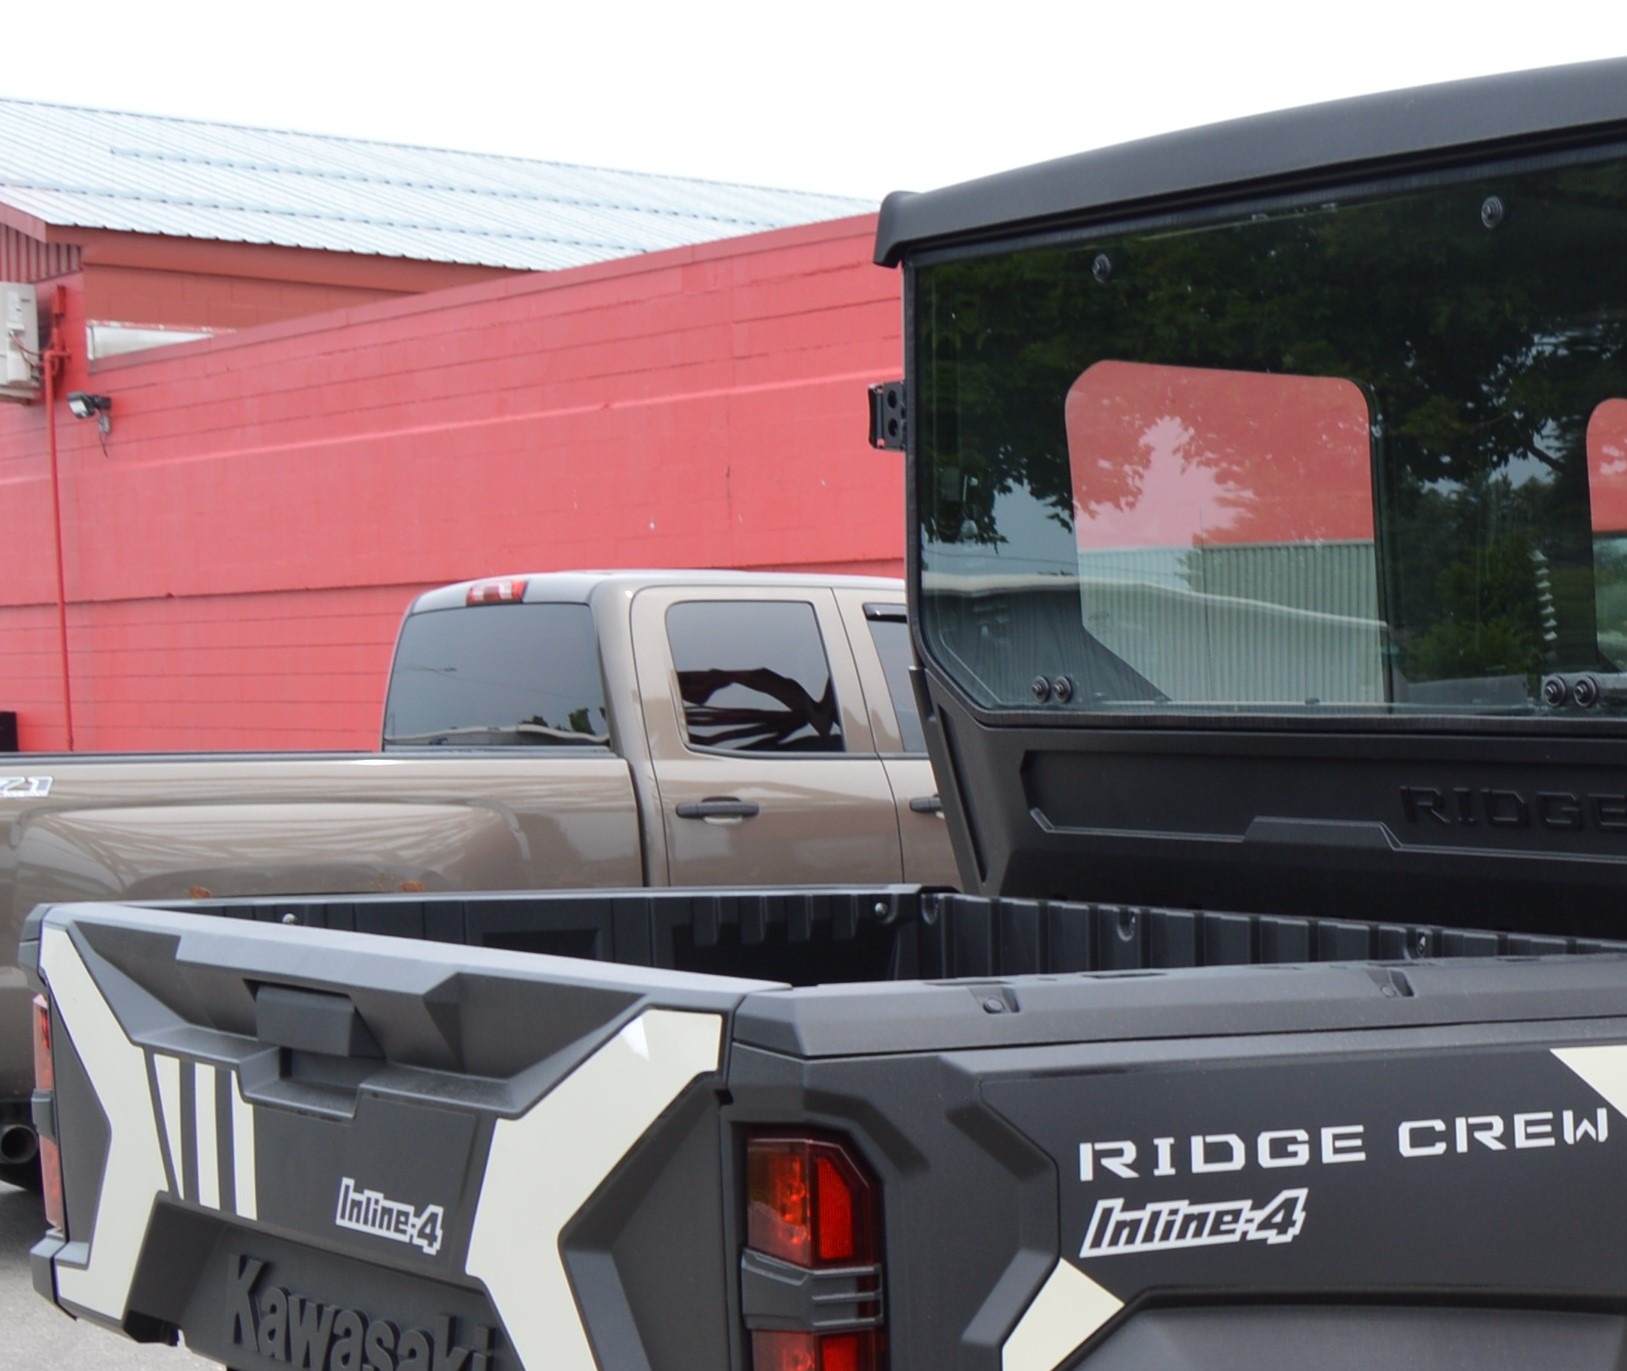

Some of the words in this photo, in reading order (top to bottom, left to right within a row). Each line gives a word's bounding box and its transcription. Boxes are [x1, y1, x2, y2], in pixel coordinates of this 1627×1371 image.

[1079, 1125, 1366, 1181] RIDGE
[1398, 1107, 1608, 1157] CREW
[335, 1176, 443, 1255] Inline-4
[1079, 1188, 1308, 1258] Inline-4
